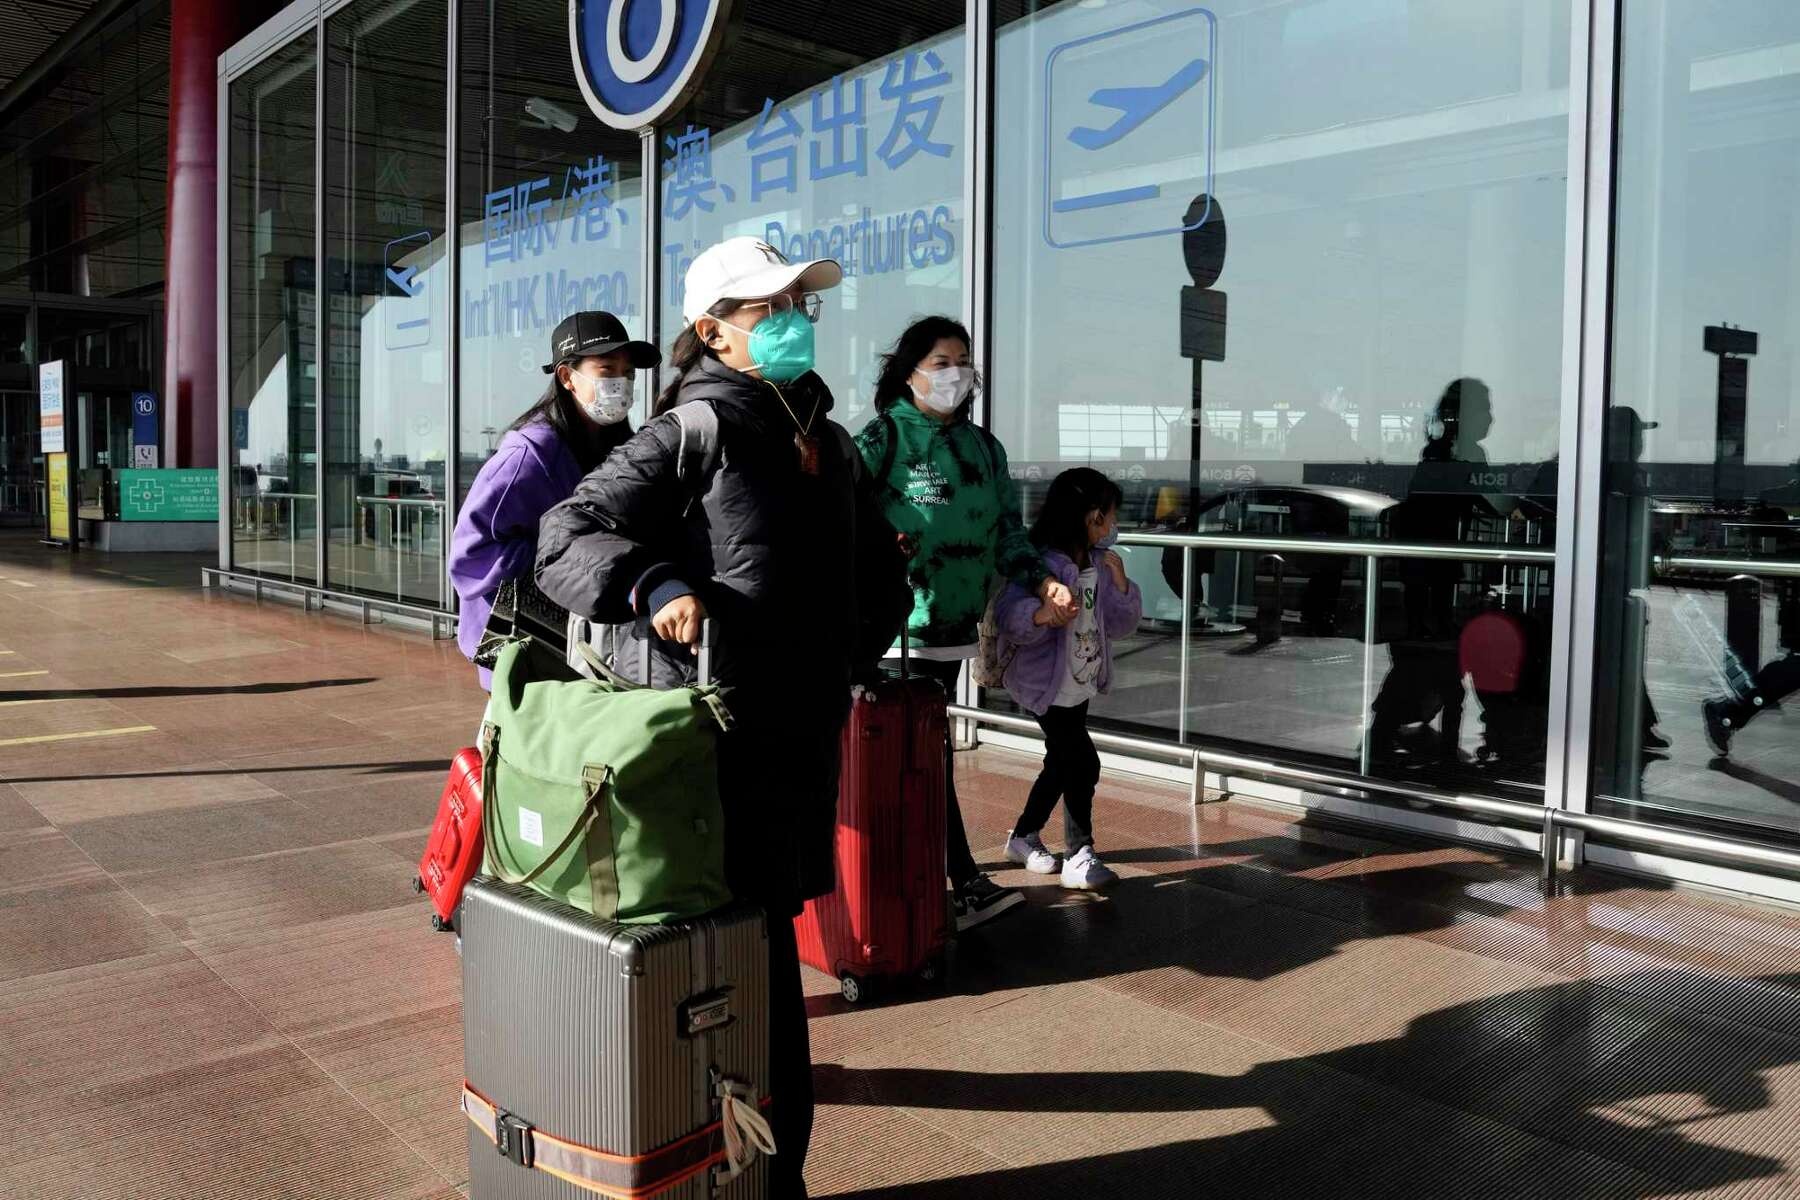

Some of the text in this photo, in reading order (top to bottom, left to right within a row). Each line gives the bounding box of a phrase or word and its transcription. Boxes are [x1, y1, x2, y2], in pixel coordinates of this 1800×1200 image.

[138, 399, 153, 412] 10
[925, 487, 941, 495] ART
[912, 495, 951, 505] SURREAL
